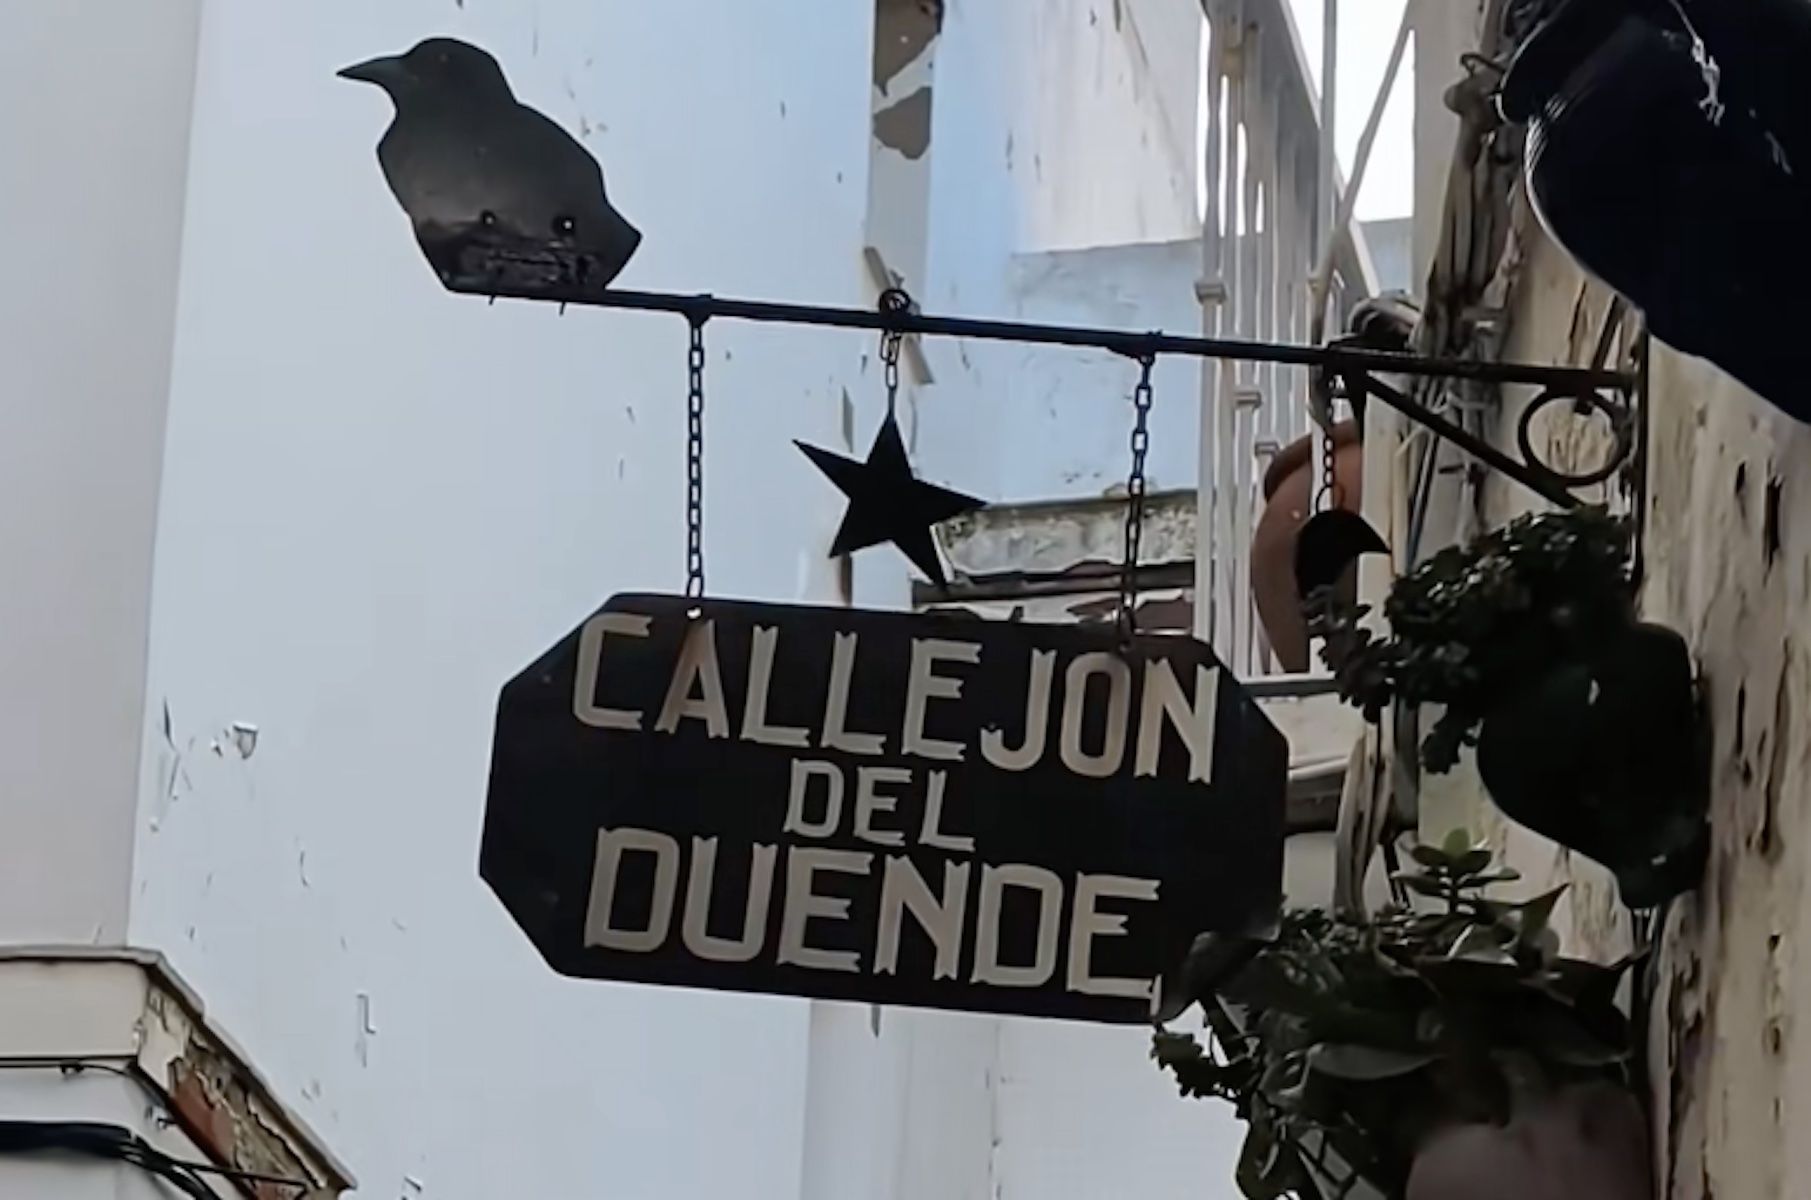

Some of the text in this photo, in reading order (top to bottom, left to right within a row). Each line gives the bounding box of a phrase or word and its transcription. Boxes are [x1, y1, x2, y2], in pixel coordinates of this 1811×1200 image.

[572, 613, 1221, 784] CALLEJON
[784, 758, 976, 851] DEL
[585, 827, 1162, 998] DUENDE
